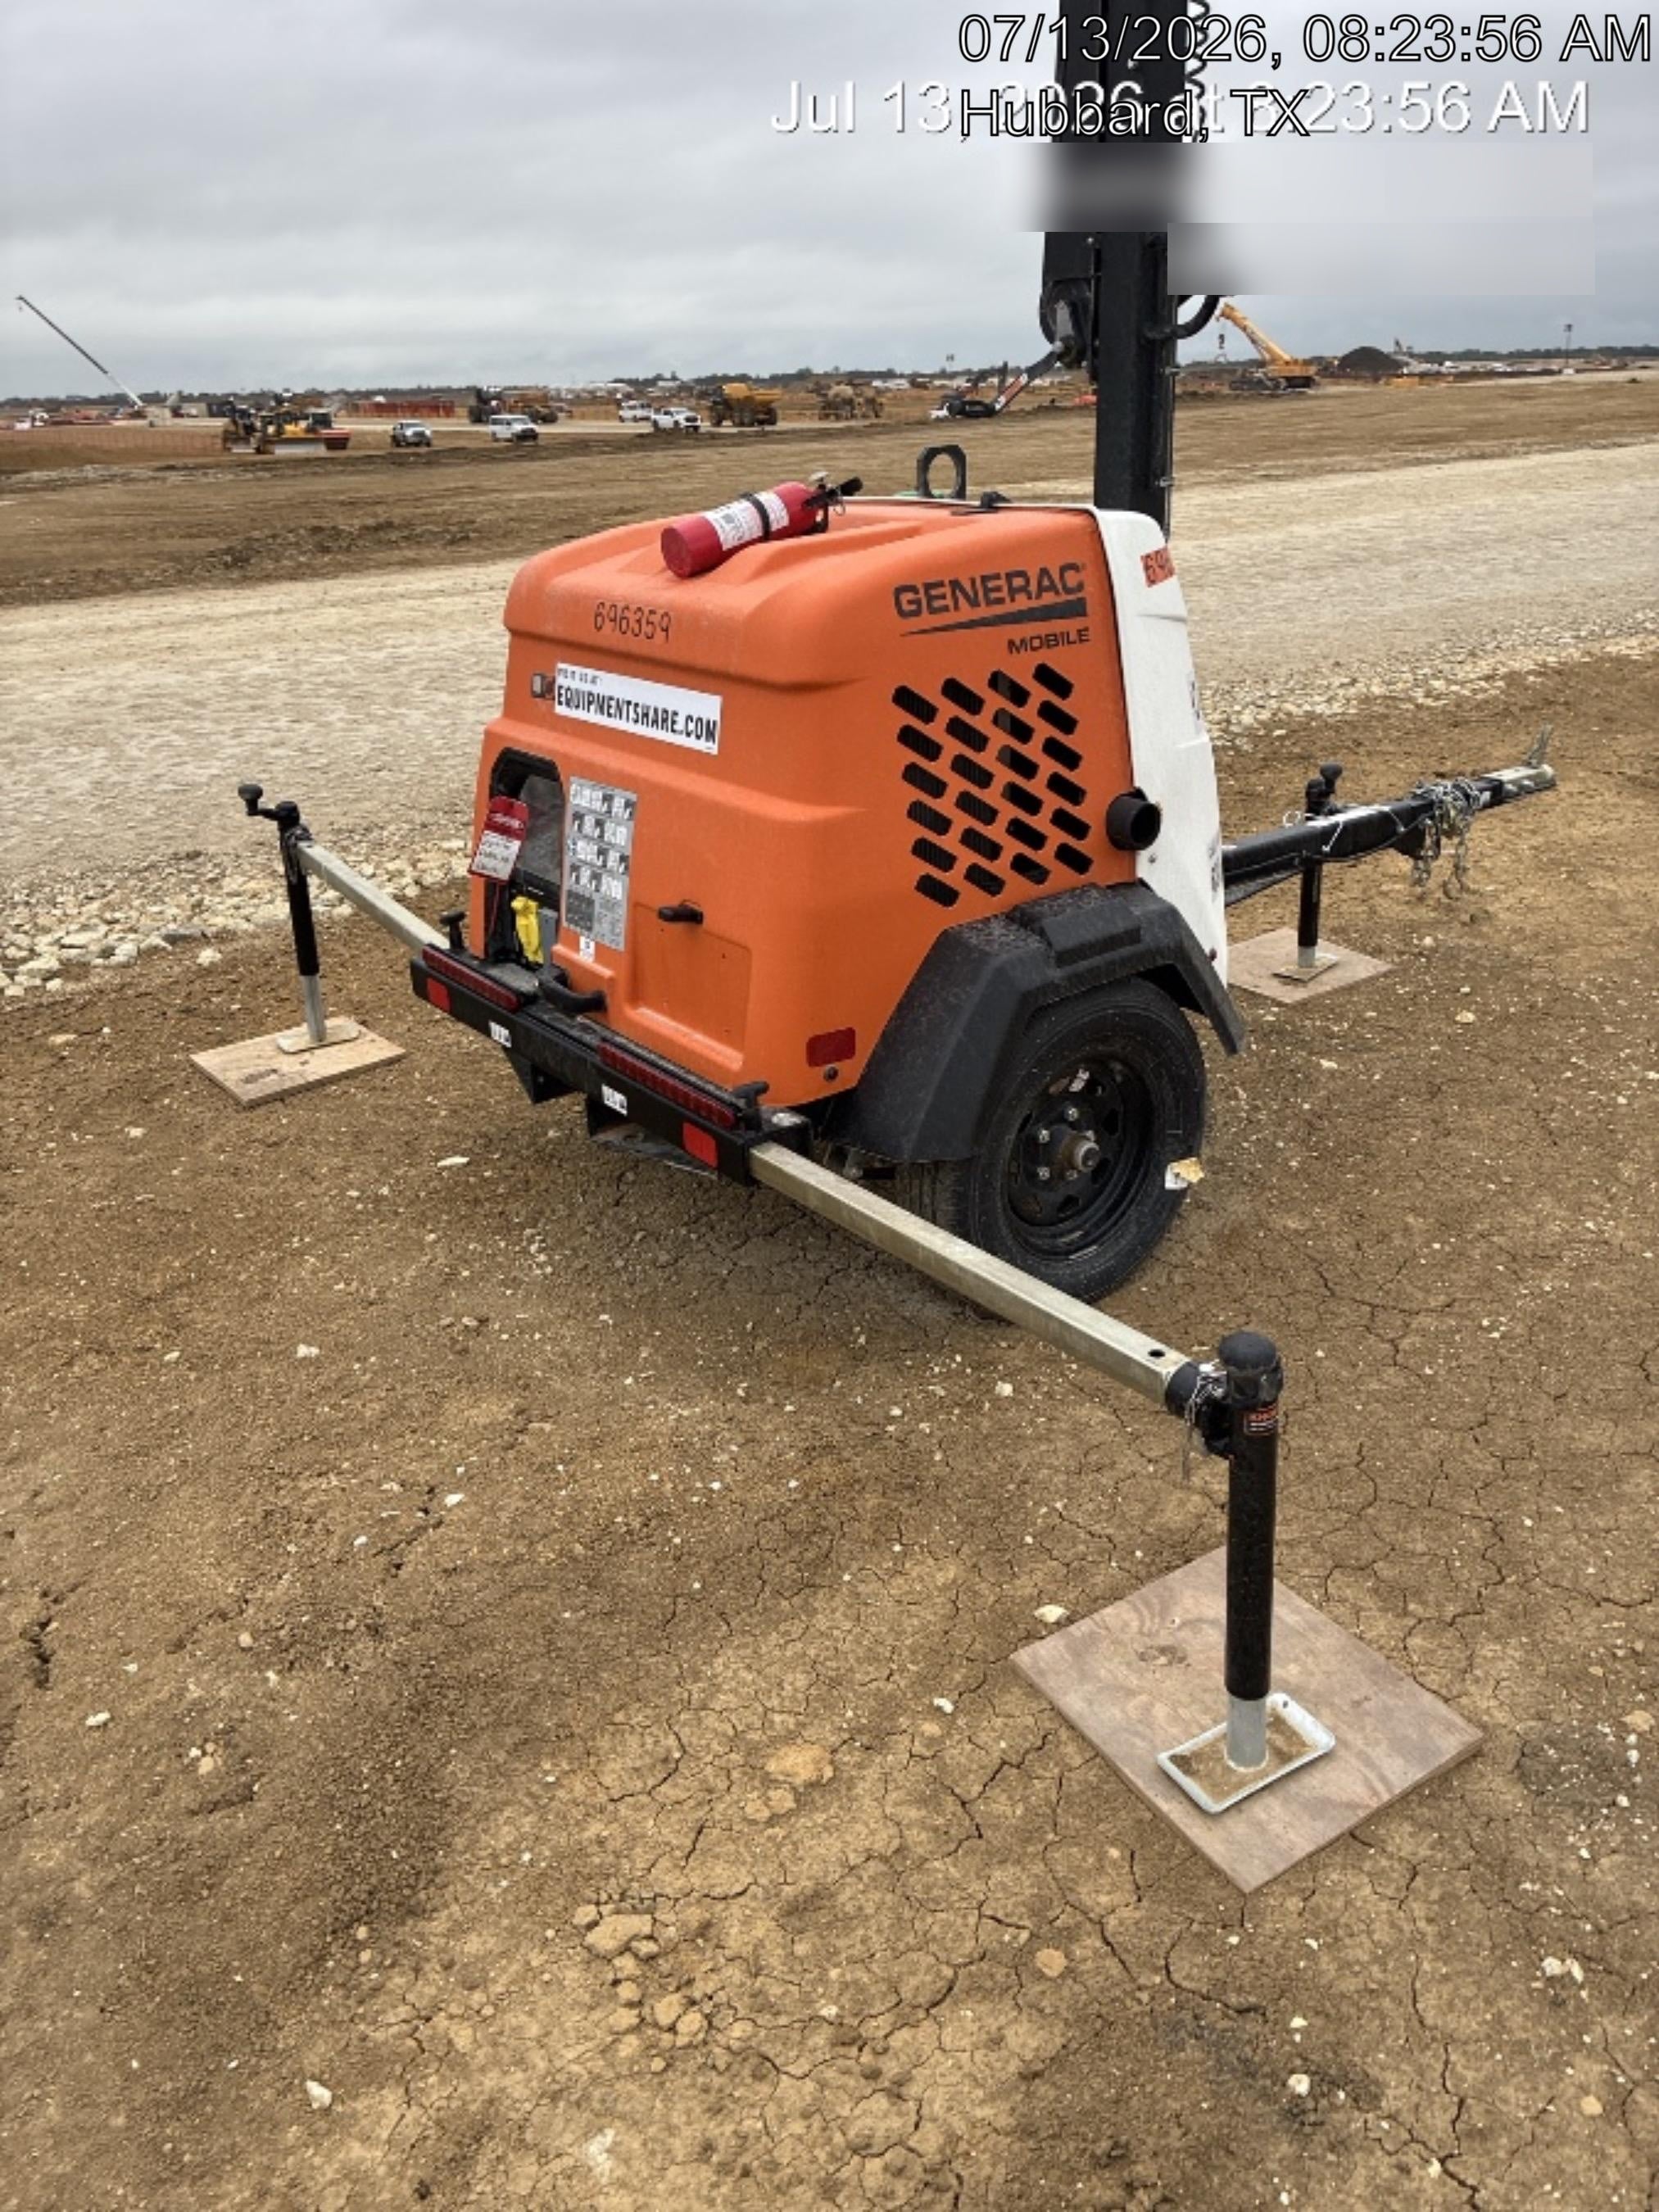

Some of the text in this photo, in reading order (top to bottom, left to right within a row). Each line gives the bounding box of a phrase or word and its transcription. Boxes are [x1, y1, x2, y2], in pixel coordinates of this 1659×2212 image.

[893, 562, 1086, 619] GENERAC
[594, 601, 672, 643] 696359
[1007, 626, 1090, 655] MOBILE
[556, 685, 718, 744] EQUIPMENTSHARE.COM
